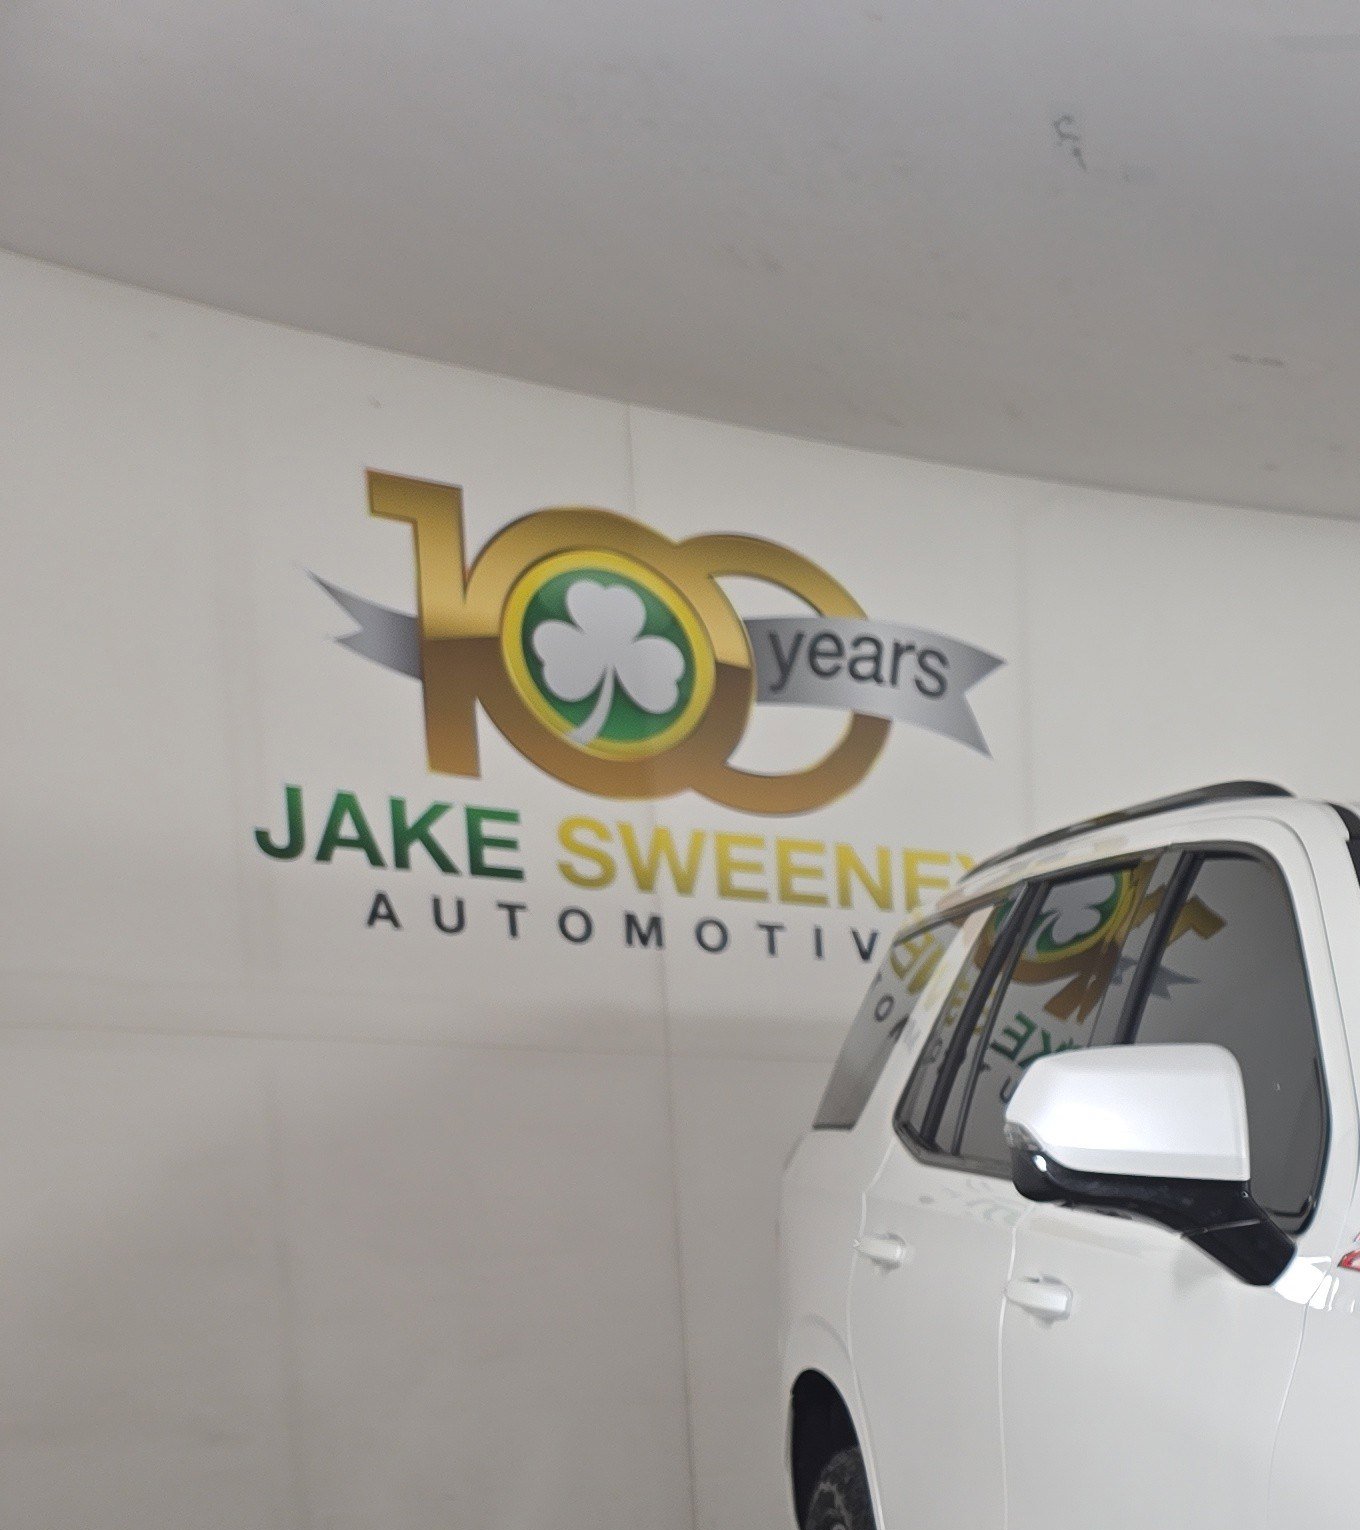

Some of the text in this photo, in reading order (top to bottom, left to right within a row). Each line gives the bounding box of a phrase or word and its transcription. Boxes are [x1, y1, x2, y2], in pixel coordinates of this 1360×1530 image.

[767, 624, 949, 699] years
[254, 784, 977, 913] JAKE SWEENE
[366, 893, 879, 962] AUTOMOTIV
